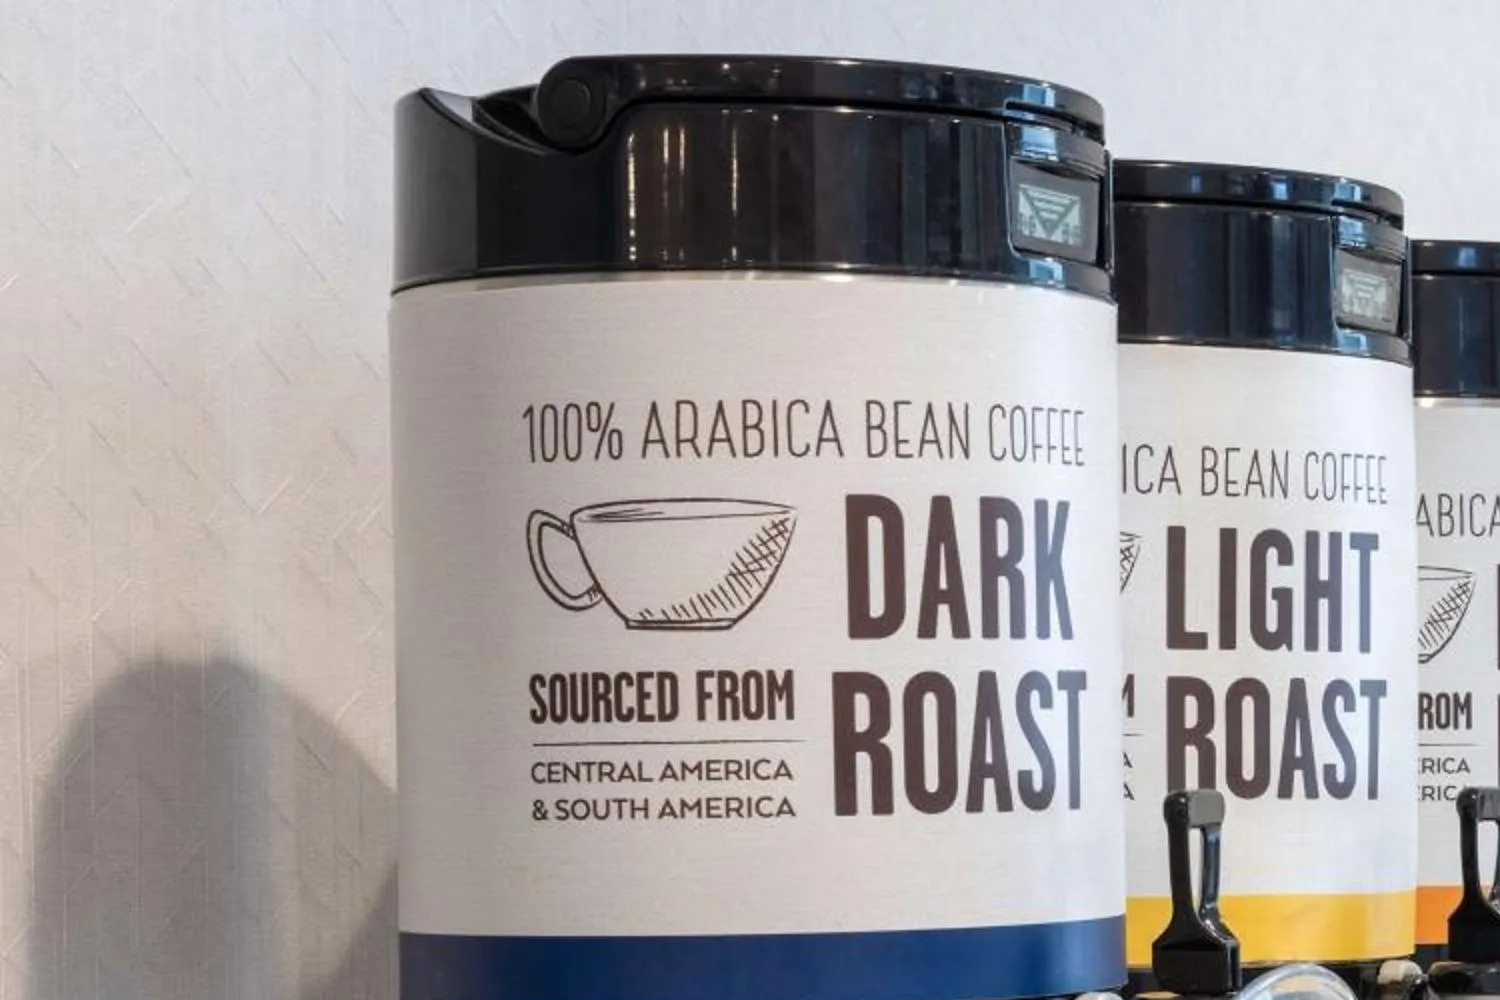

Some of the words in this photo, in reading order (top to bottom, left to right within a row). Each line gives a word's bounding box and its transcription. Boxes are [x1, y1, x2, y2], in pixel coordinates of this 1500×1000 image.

[522, 401, 623, 463] 100%
[641, 399, 845, 459] ARABICA
[865, 399, 970, 460] BEAN
[988, 403, 1084, 467] COFFEE
[1200, 446, 1289, 500] BEAN
[1304, 450, 1387, 504] COFFEE
[845, 493, 1074, 640] DARK
[1165, 525, 1380, 654] LIGHT
[529, 670, 680, 725] SOURCED
[696, 669, 795, 722] FROM
[831, 670, 1087, 817] ROAST
[1164, 675, 1387, 800] ROAST
[1417, 757, 1470, 774] RICA
[531, 760, 653, 784] CENTRAL
[658, 758, 794, 782] AMERICA
[532, 799, 549, 821] &
[554, 798, 650, 821] SOUTH
[658, 795, 796, 820] AMERICA
